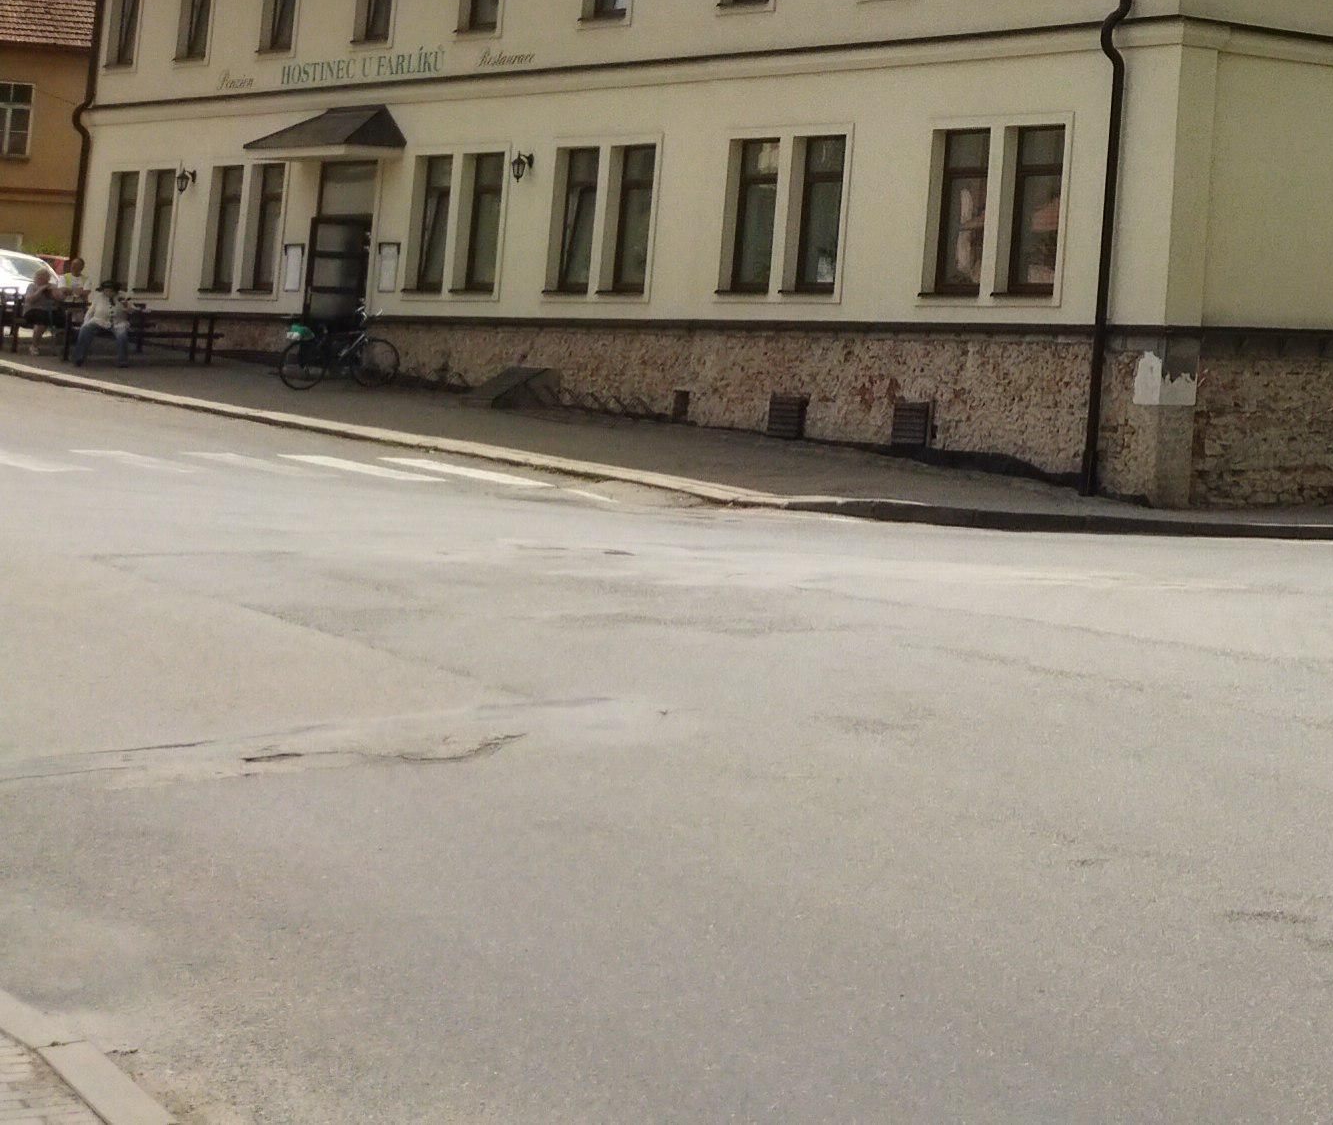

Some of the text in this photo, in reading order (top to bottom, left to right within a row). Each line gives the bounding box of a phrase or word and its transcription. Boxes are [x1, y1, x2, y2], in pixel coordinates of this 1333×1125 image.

[281, 58, 356, 85] HOSTINEC
[361, 56, 374, 78] U
[377, 44, 446, 76] FARLÍKŮ
